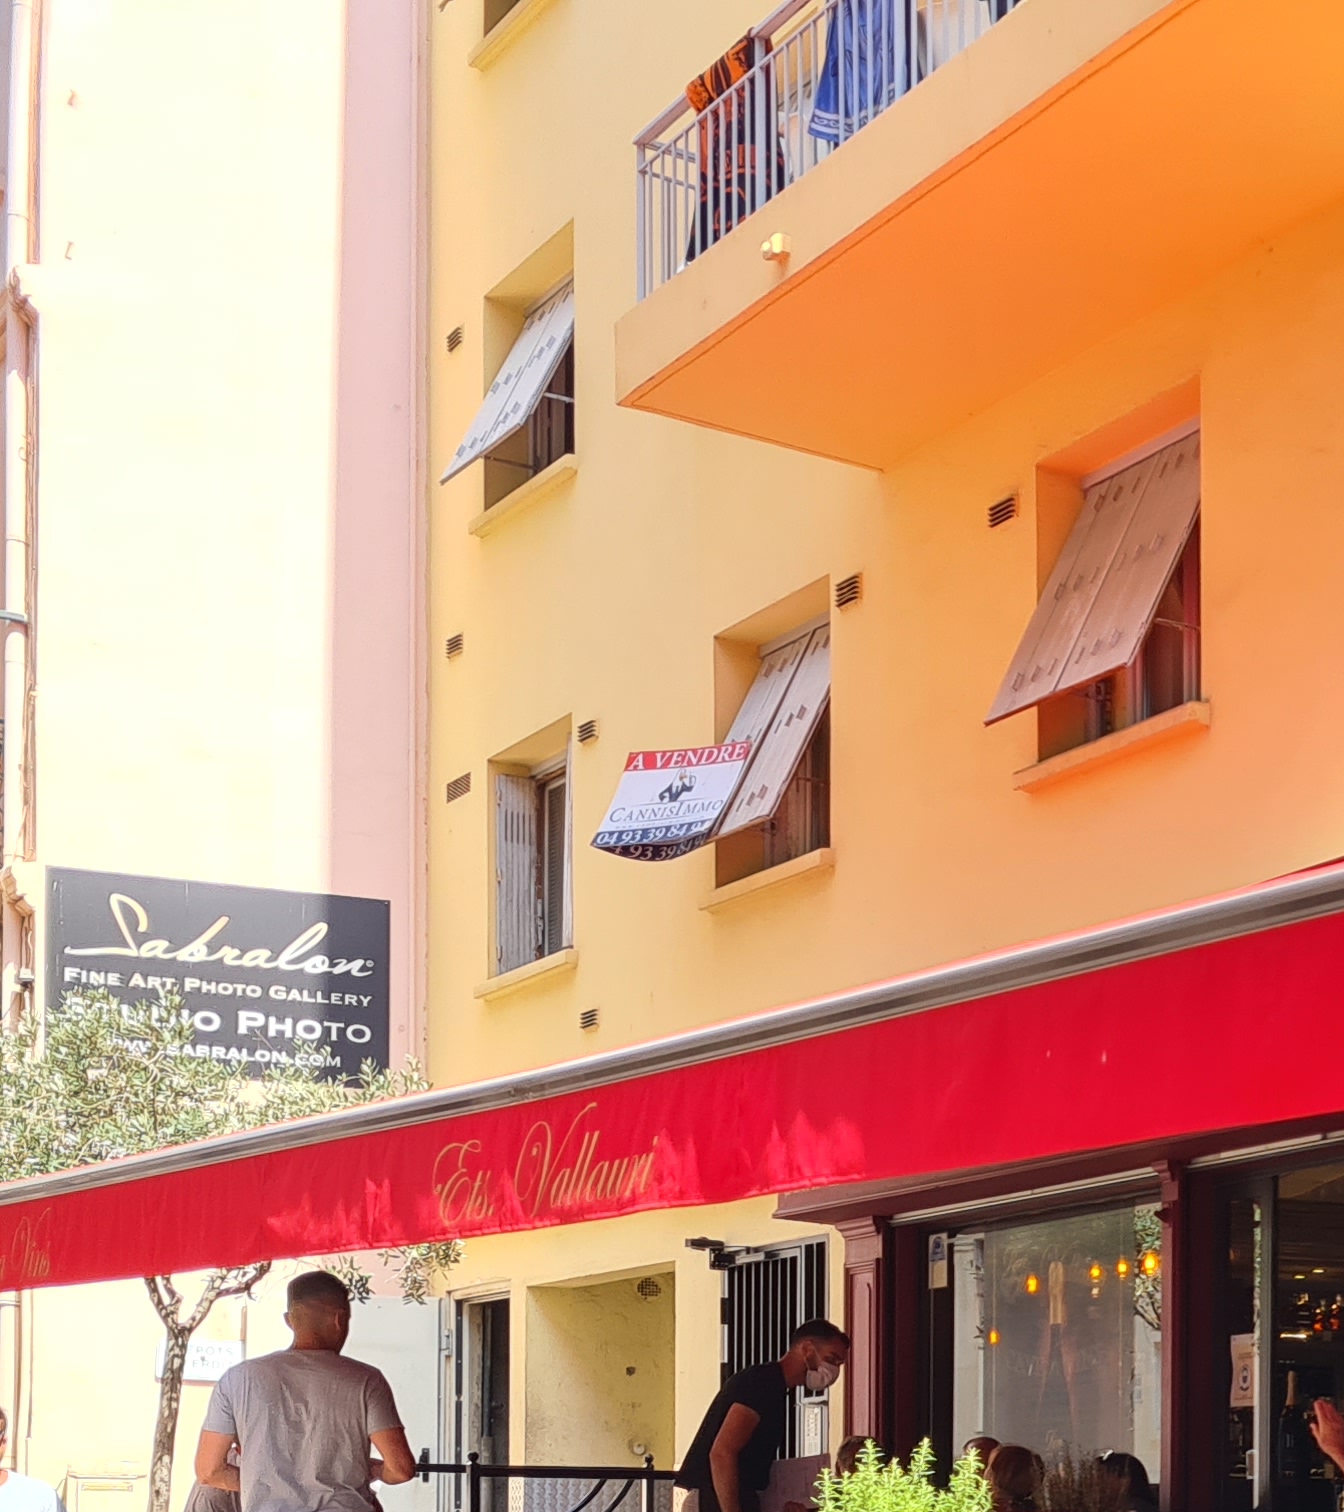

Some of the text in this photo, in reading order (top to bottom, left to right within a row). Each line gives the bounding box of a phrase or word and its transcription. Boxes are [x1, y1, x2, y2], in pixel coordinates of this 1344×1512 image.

[627, 743, 748, 770] A VENDRE
[597, 832, 617, 846] 04
[621, 830, 643, 845] 93
[643, 827, 667, 843] 39
[63, 966, 373, 1008] FINE ART PHOTO GALLERY
[237, 1009, 372, 1044] PHOTO
[514, 1102, 659, 1218] Vallauri
